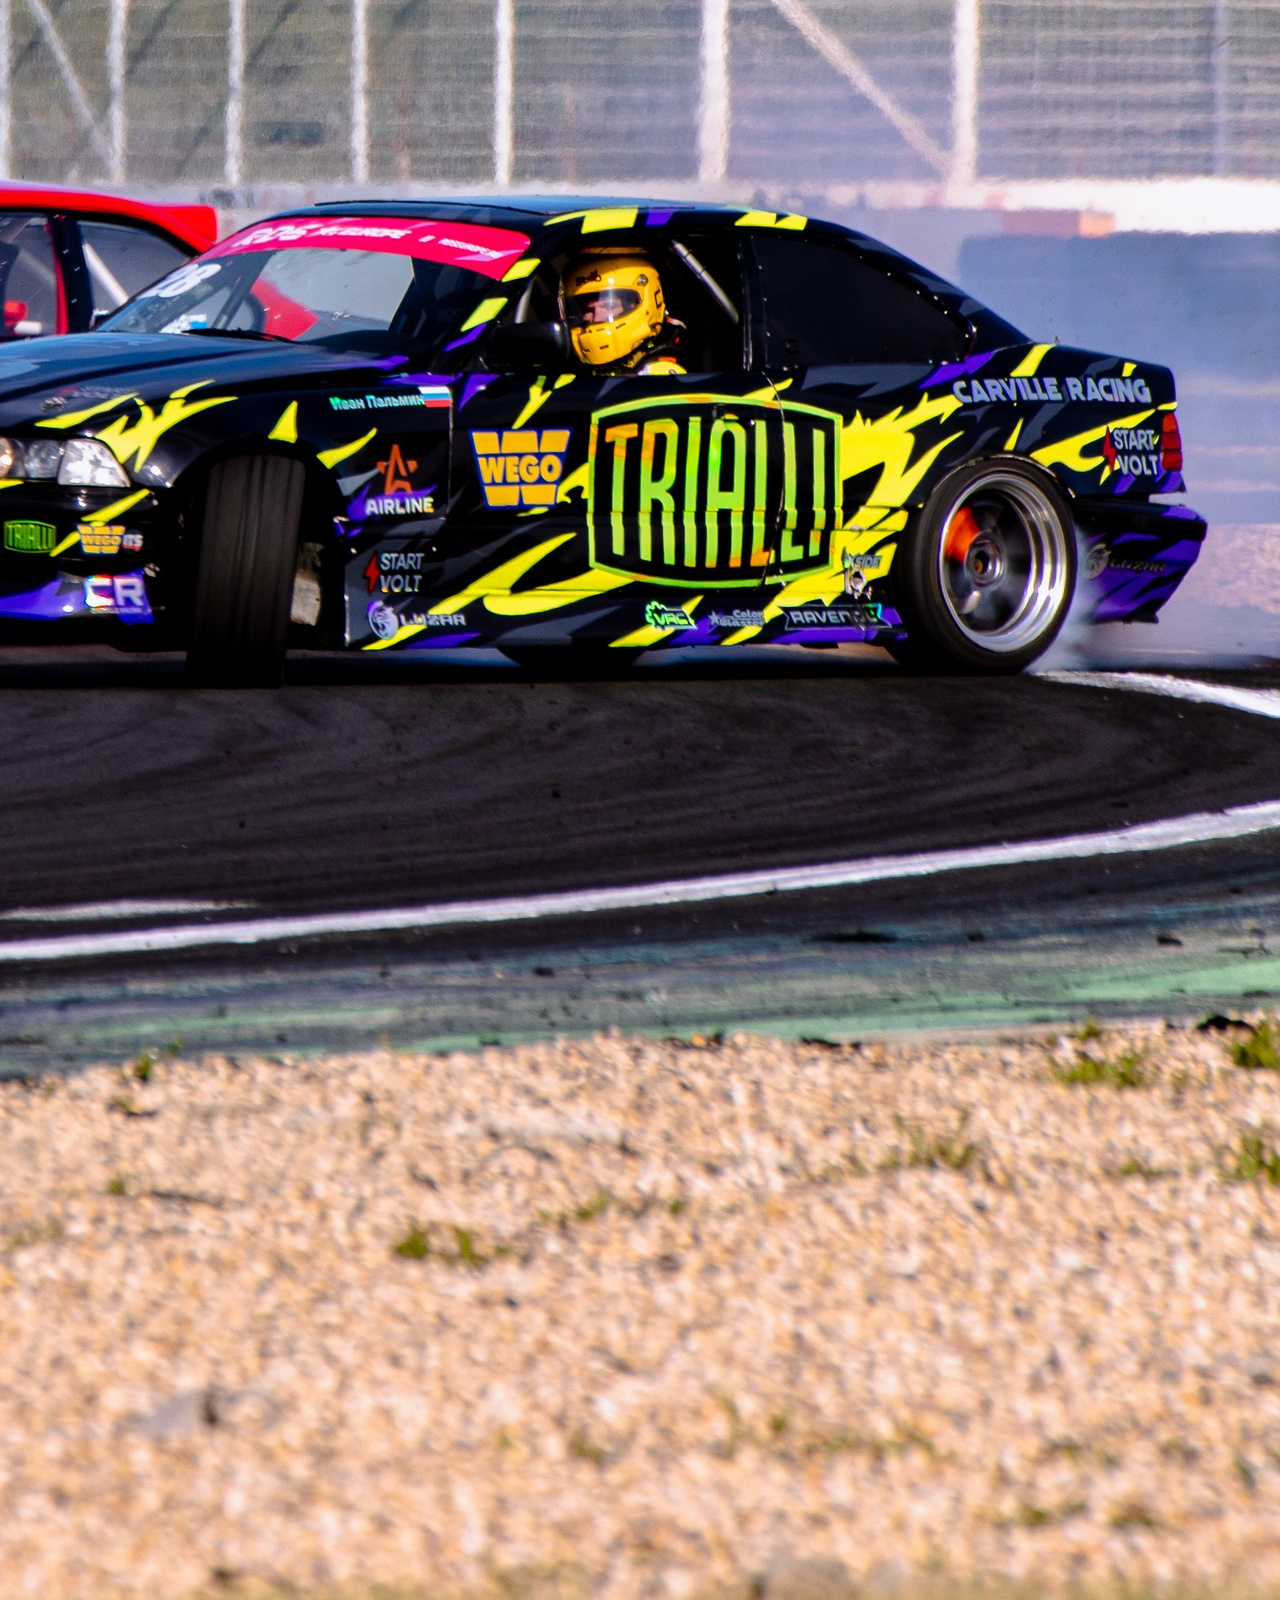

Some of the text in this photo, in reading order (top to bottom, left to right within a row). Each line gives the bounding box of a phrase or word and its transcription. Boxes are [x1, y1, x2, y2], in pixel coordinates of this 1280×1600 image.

[231, 223, 321, 248] RDS
[953, 376, 1152, 404] CARVILLE RACING
[1113, 429, 1154, 451] START
[478, 455, 562, 483] WEGO
[1117, 454, 1158, 475] VOLT
[604, 415, 826, 569] TRIALLI
[365, 497, 435, 515] AIRLINE
[81, 535, 122, 546] WEGO
[380, 552, 425, 571] START
[84, 575, 145, 607] CR
[380, 574, 423, 593] VOLT
[400, 613, 466, 626] LUZAR
